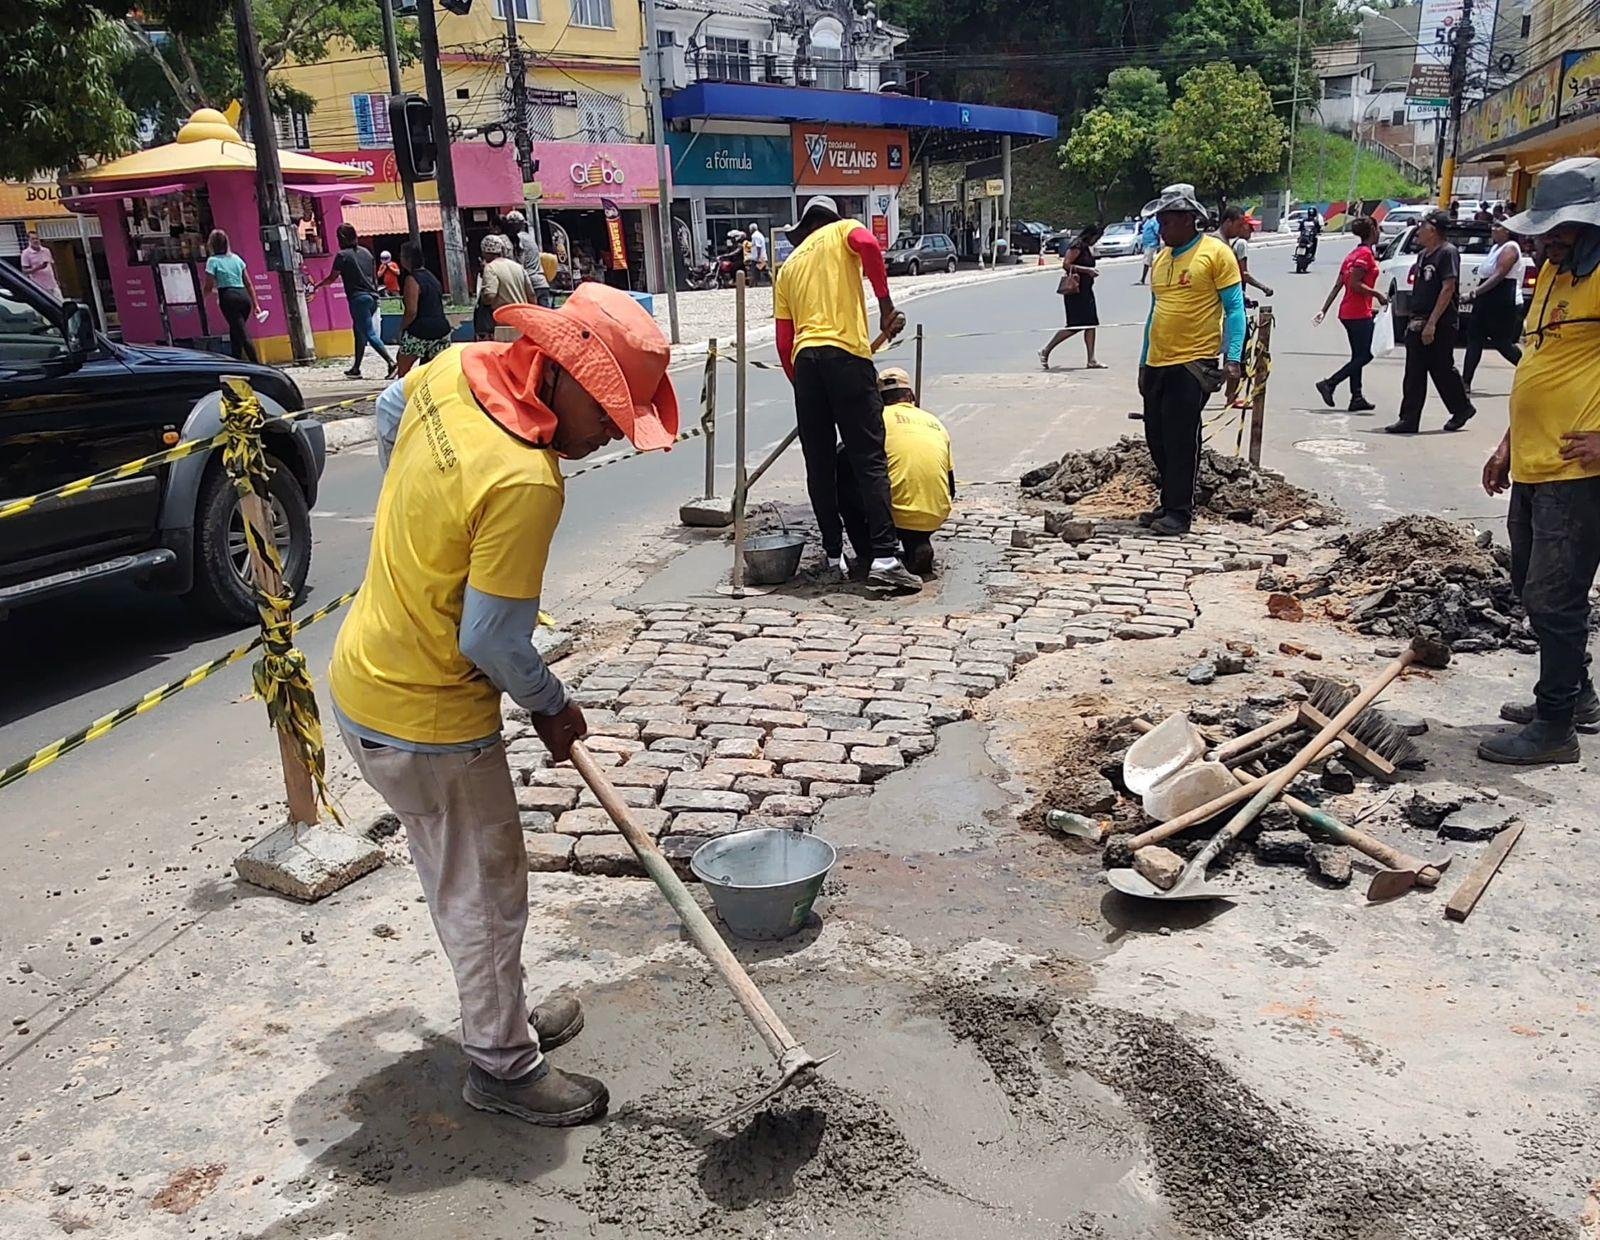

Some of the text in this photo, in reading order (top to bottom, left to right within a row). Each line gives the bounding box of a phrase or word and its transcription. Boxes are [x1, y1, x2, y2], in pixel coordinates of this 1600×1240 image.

[706, 157, 713, 169] a
[829, 151, 877, 168] VELANES
[439, 439, 458, 468] ILHÉUS
